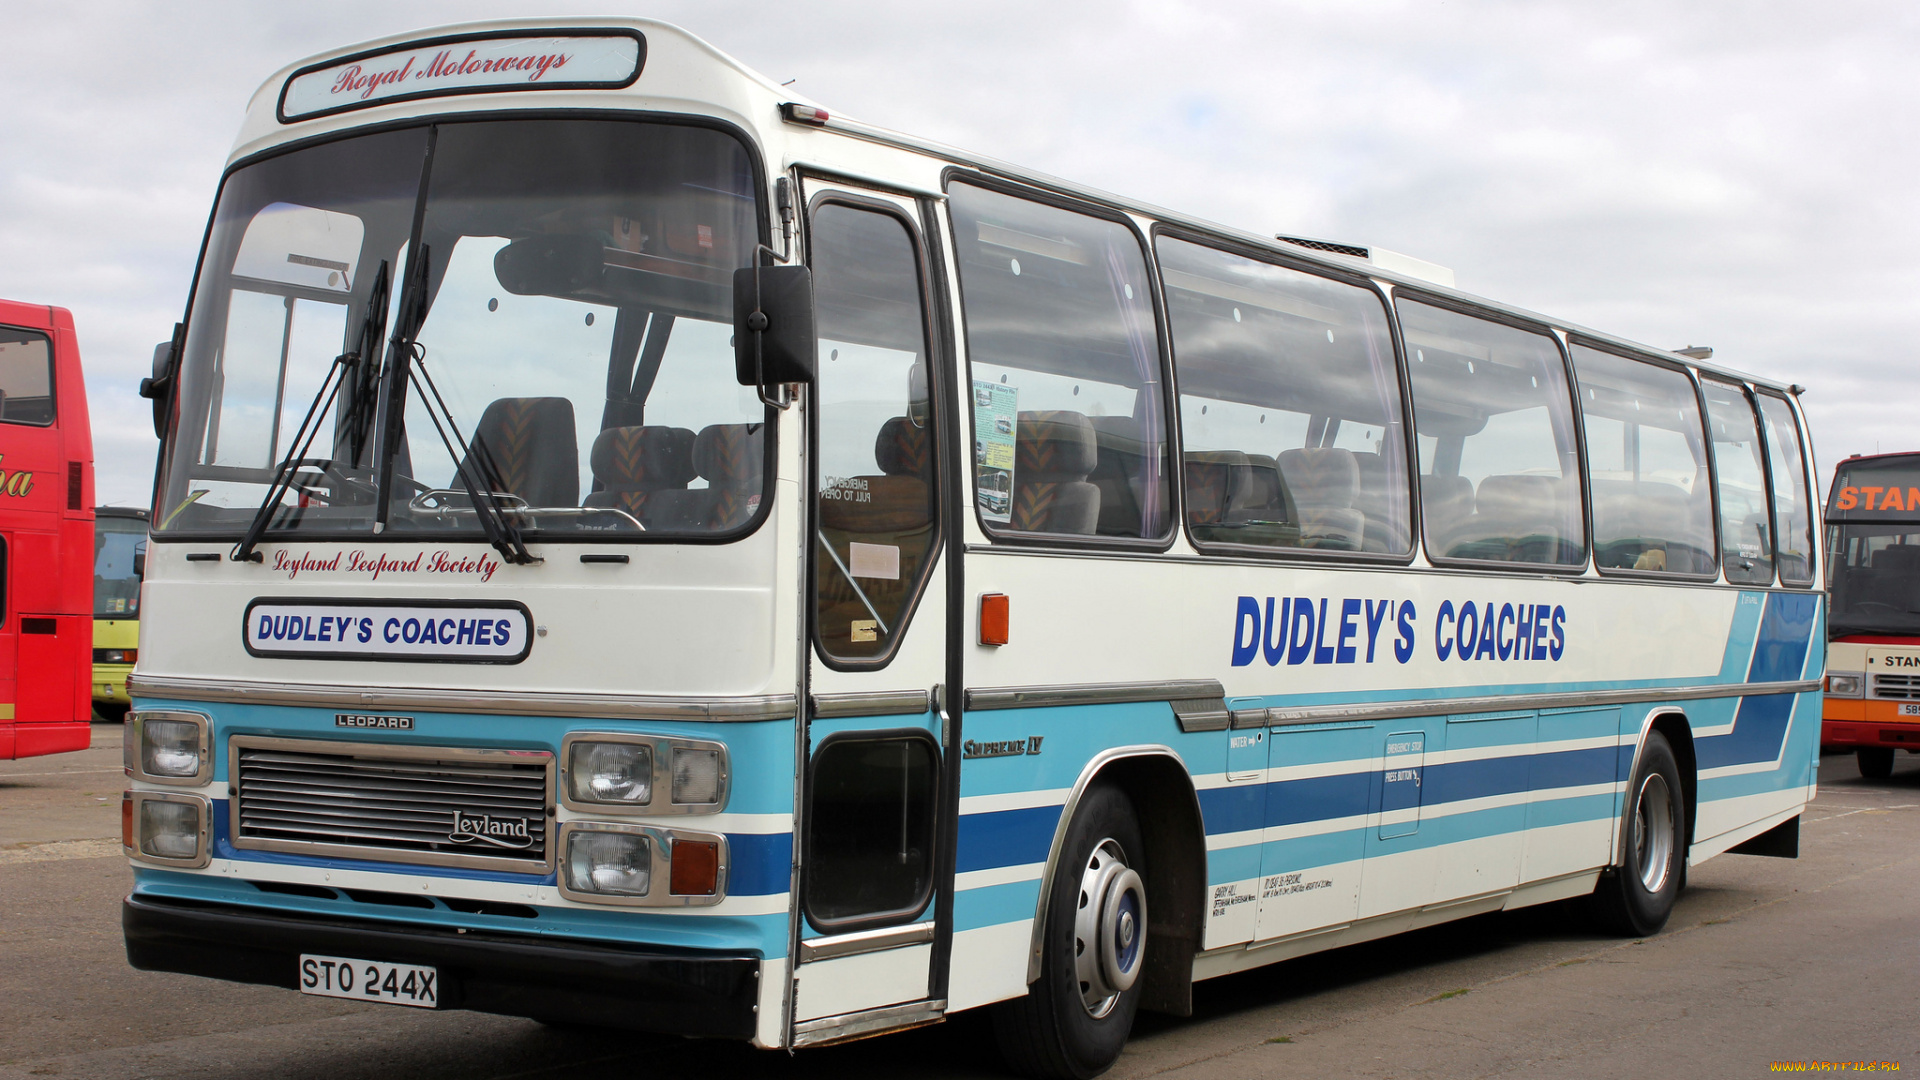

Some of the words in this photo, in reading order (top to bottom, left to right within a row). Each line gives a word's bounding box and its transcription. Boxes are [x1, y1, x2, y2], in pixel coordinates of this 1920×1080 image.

[331, 56, 415, 100] Royal
[415, 49, 574, 83] Motorways
[272, 549, 342, 579] Leyland
[345, 550, 424, 580] Leopard
[427, 550, 502, 583] Society
[258, 615, 373, 643] DUDLEY'S
[383, 617, 511, 646] COACHES
[1231, 595, 1416, 666] DUDLEY'S
[1435, 599, 1567, 662] COACHES
[337, 715, 411, 729] LEOPARD
[1027, 736, 1044, 755] IV
[1230, 736, 1248, 749] WATER
[1387, 742, 1411, 754] EMERGENCY
[1385, 771, 1397, 783] PRESS
[1397, 769, 1412, 781] BUTTON
[448, 811, 534, 849] Leyland
[302, 958, 354, 991] STO
[364, 962, 436, 1002] 244X
